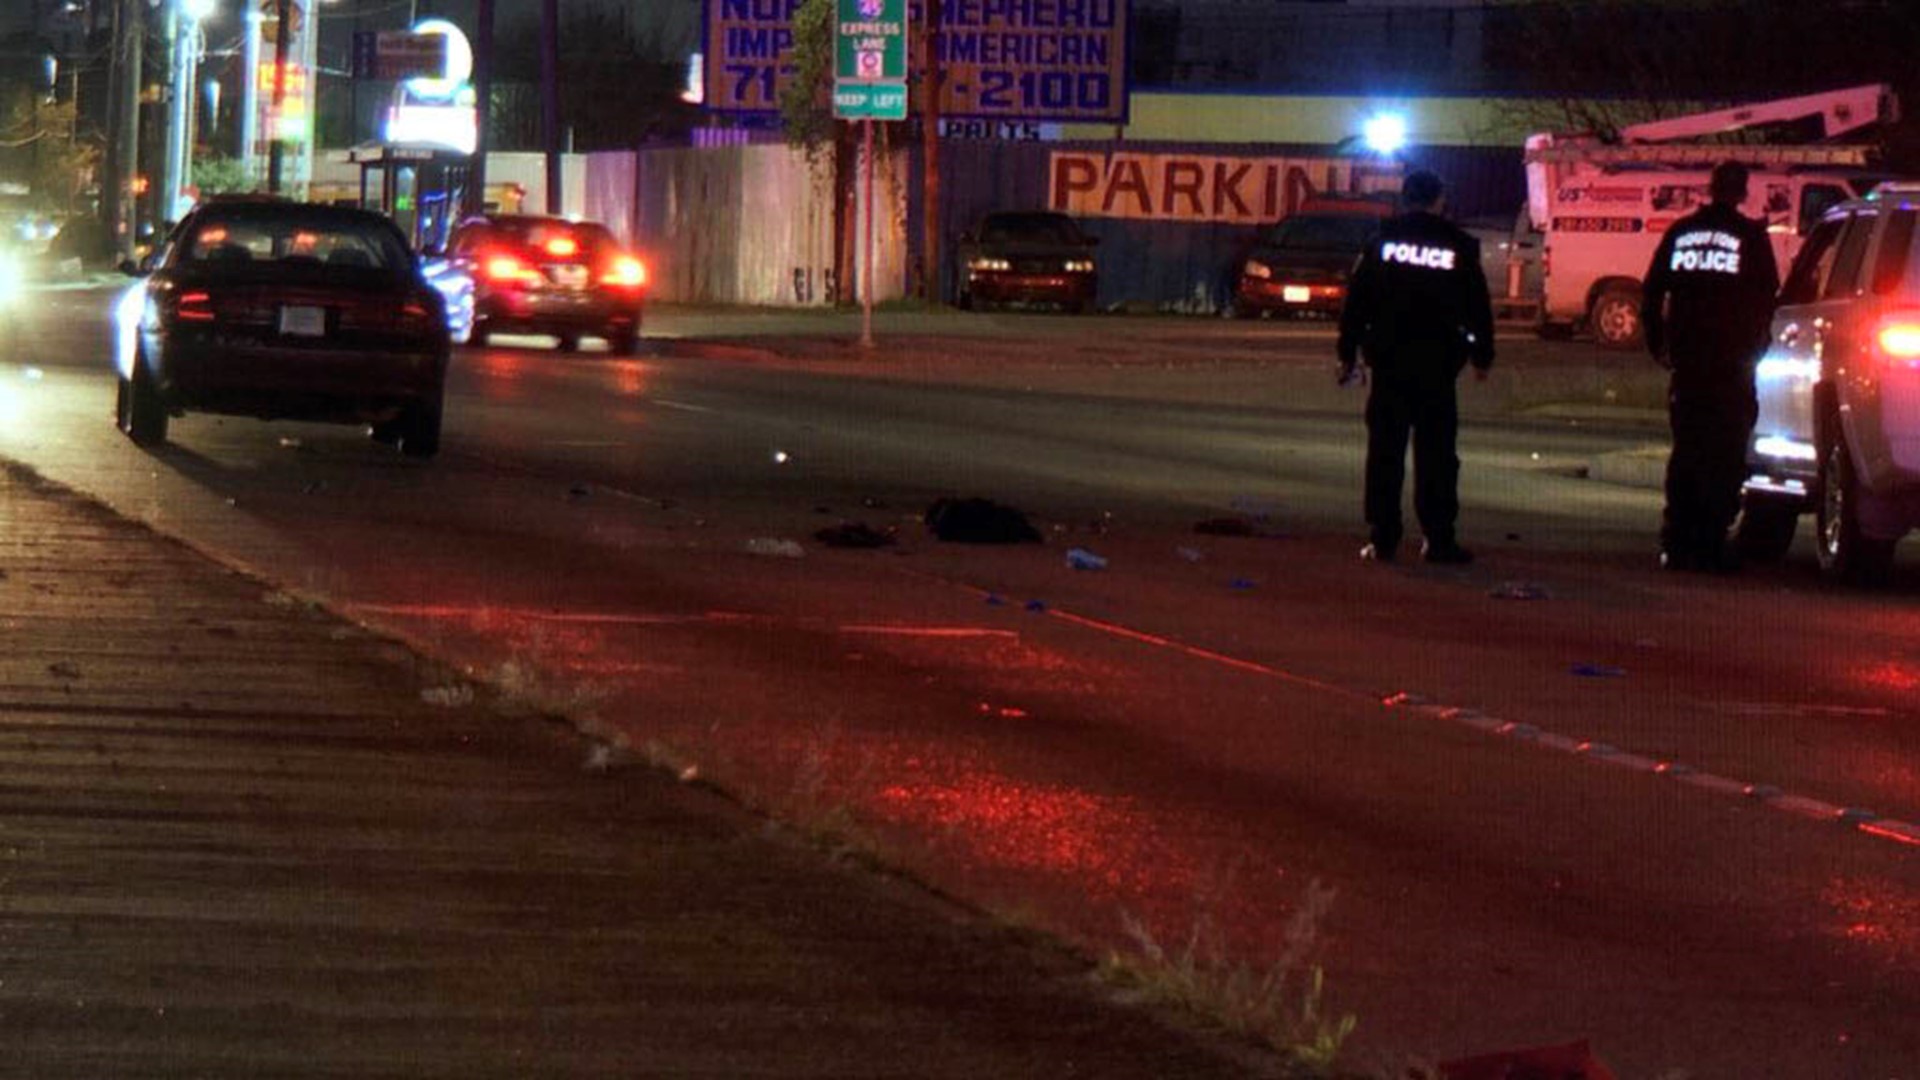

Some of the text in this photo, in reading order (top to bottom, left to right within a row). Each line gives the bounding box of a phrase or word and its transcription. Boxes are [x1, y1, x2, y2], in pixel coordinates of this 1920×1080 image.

[907, 0, 1115, 27] EPHERD
[841, 22, 899, 36] EXPRESS
[728, 28, 796, 58] IMP
[853, 37, 886, 51] LANE
[725, 64, 799, 101] 71
[835, 93, 903, 108] KEEP LEFT
[1382, 242, 1456, 270] POLICE
[1670, 250, 1740, 275] POLICE
